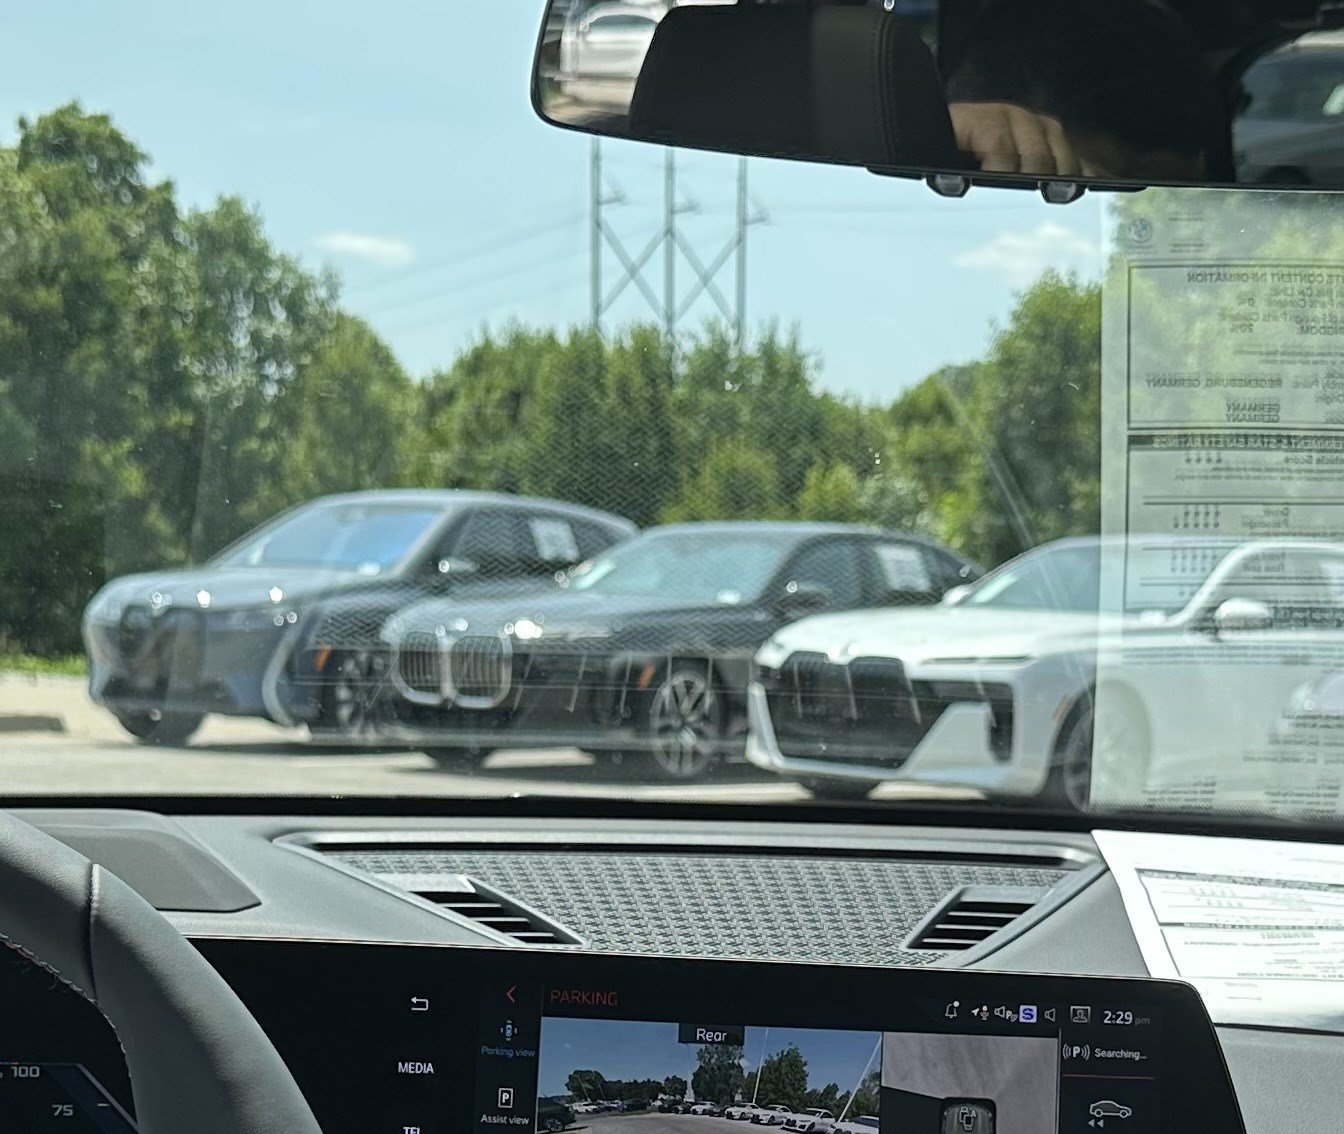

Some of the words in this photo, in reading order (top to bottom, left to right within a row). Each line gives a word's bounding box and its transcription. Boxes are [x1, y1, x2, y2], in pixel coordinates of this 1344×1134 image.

[550, 989, 619, 1006] PARKING
[1102, 1010, 1133, 1025] 2:29
[1134, 1017, 1151, 1026] pm
[696, 1027, 728, 1042] Rear
[481, 1045, 511, 1058] Parking
[513, 1048, 535, 1058] view
[10, 1065, 40, 1078] 100
[397, 1061, 435, 1074] MEDIA
[51, 1104, 74, 1117] 75
[480, 1113, 507, 1124] Assist
[508, 1115, 530, 1126] view
